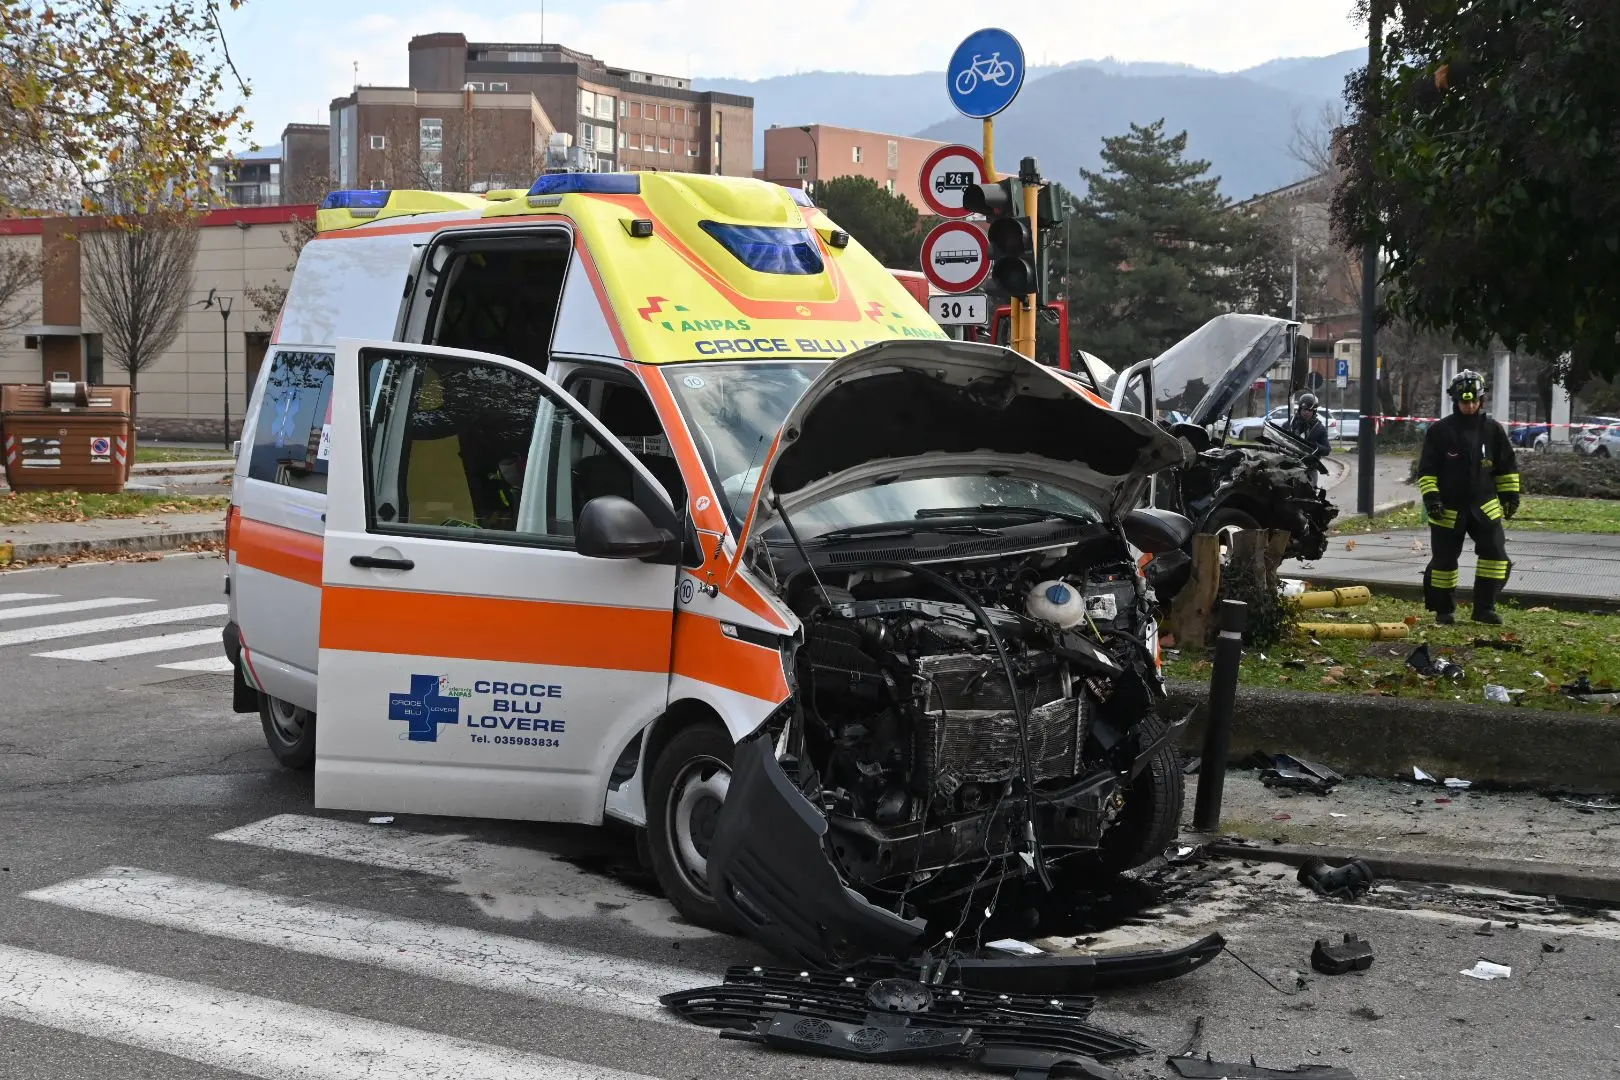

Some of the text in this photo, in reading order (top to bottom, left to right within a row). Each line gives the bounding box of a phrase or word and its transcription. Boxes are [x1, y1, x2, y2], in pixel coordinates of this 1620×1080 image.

[949, 173, 969, 185] 26 t
[940, 302, 975, 319] 30 t
[681, 319, 751, 333] ANPAS
[695, 338, 792, 355] CROCE
[795, 338, 847, 353] BLU
[1338, 361, 1346, 374] P
[683, 585, 692, 598] 10
[474, 680, 562, 698] CROCE
[391, 699, 422, 707] CROCE
[493, 699, 541, 714] BLU
[404, 708, 422, 716] BLU
[467, 714, 566, 733] LOVERE
[470, 734, 560, 748] Tel. 035983834
